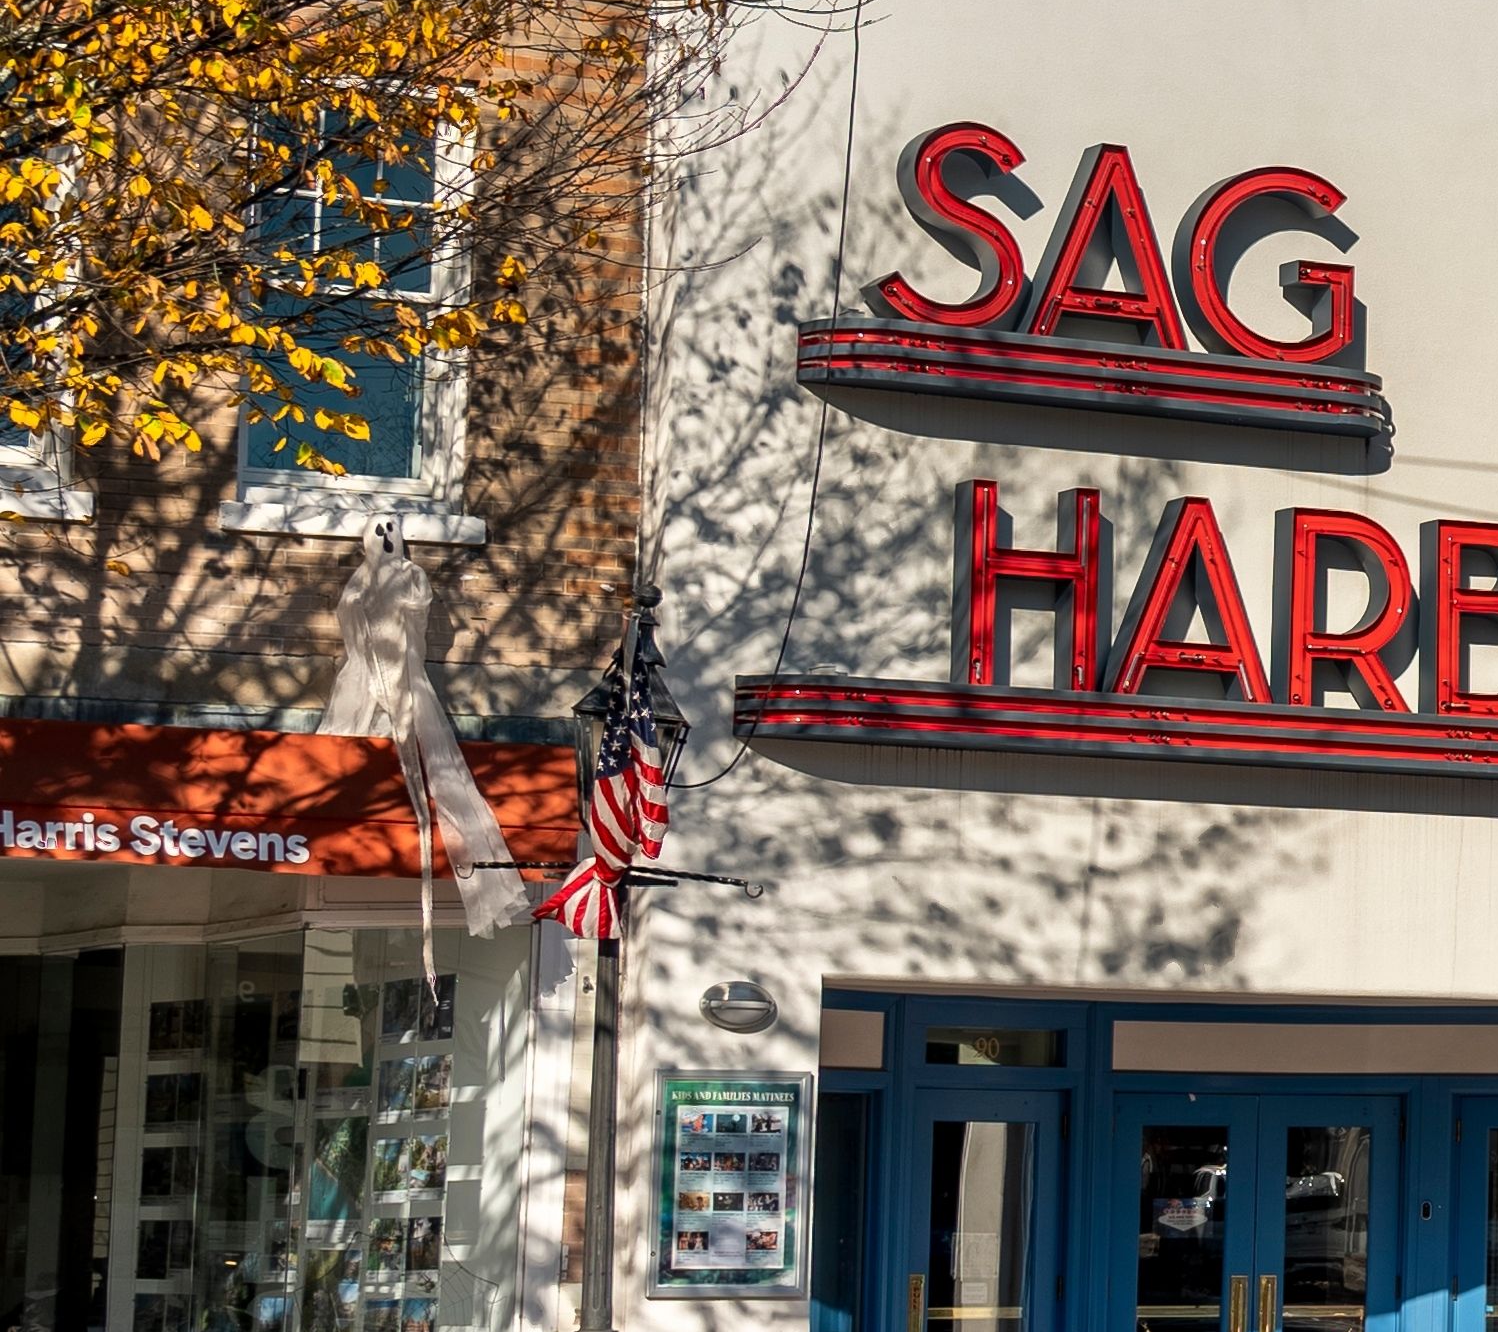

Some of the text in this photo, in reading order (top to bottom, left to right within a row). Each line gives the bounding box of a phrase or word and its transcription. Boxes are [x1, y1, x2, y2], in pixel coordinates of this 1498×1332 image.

[862, 120, 1364, 368] SAG
[130, 815, 310, 864] Stevens
[975, 1036, 1000, 1059] 90
[671, 1090, 795, 1103] KIDS AND FAMILIES MATINEES
